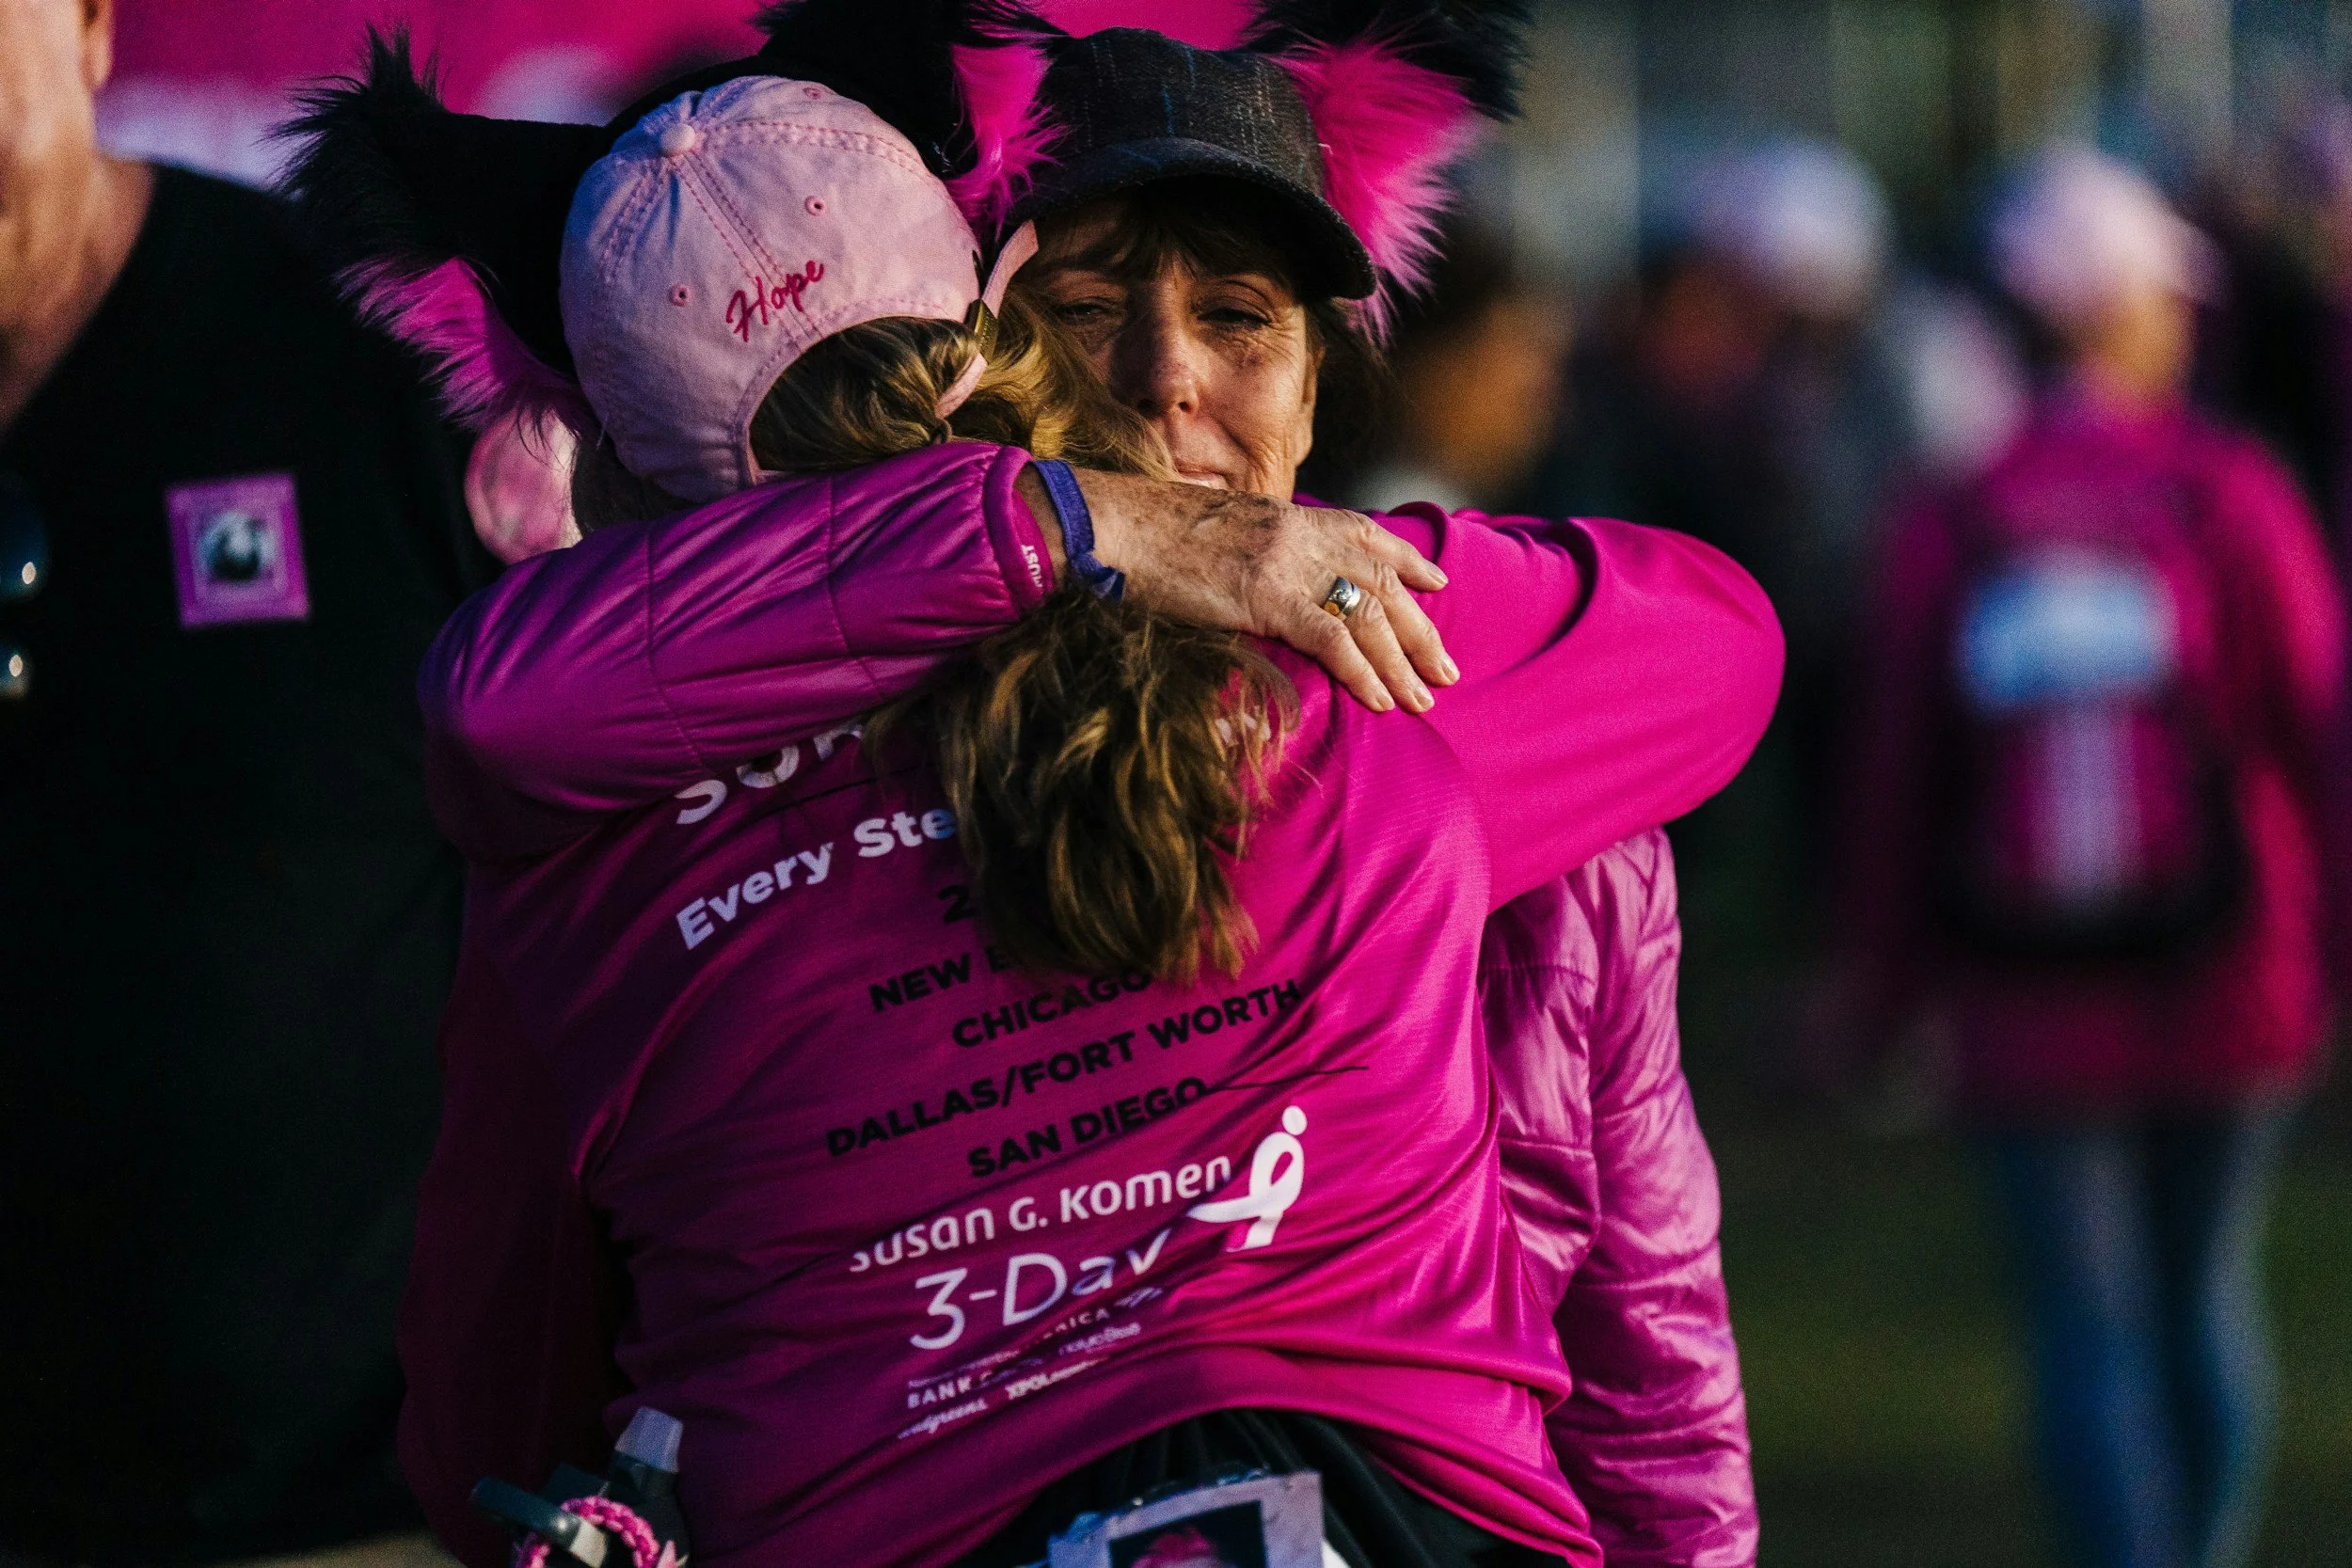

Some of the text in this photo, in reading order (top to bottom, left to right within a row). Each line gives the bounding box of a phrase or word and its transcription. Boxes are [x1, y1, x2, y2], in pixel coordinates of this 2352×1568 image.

[725, 260, 825, 343] Hope
[675, 808, 956, 951] Every Ste
[868, 953, 971, 1013] NEW
[951, 969, 1152, 1048] CHICAGO
[825, 978, 1302, 1157] DALLAS/FORT WORTH
[967, 1076, 1206, 1178] SAN DIEGO
[1009, 1196, 1049, 1232] G.
[907, 1375, 973, 1409] BANK
